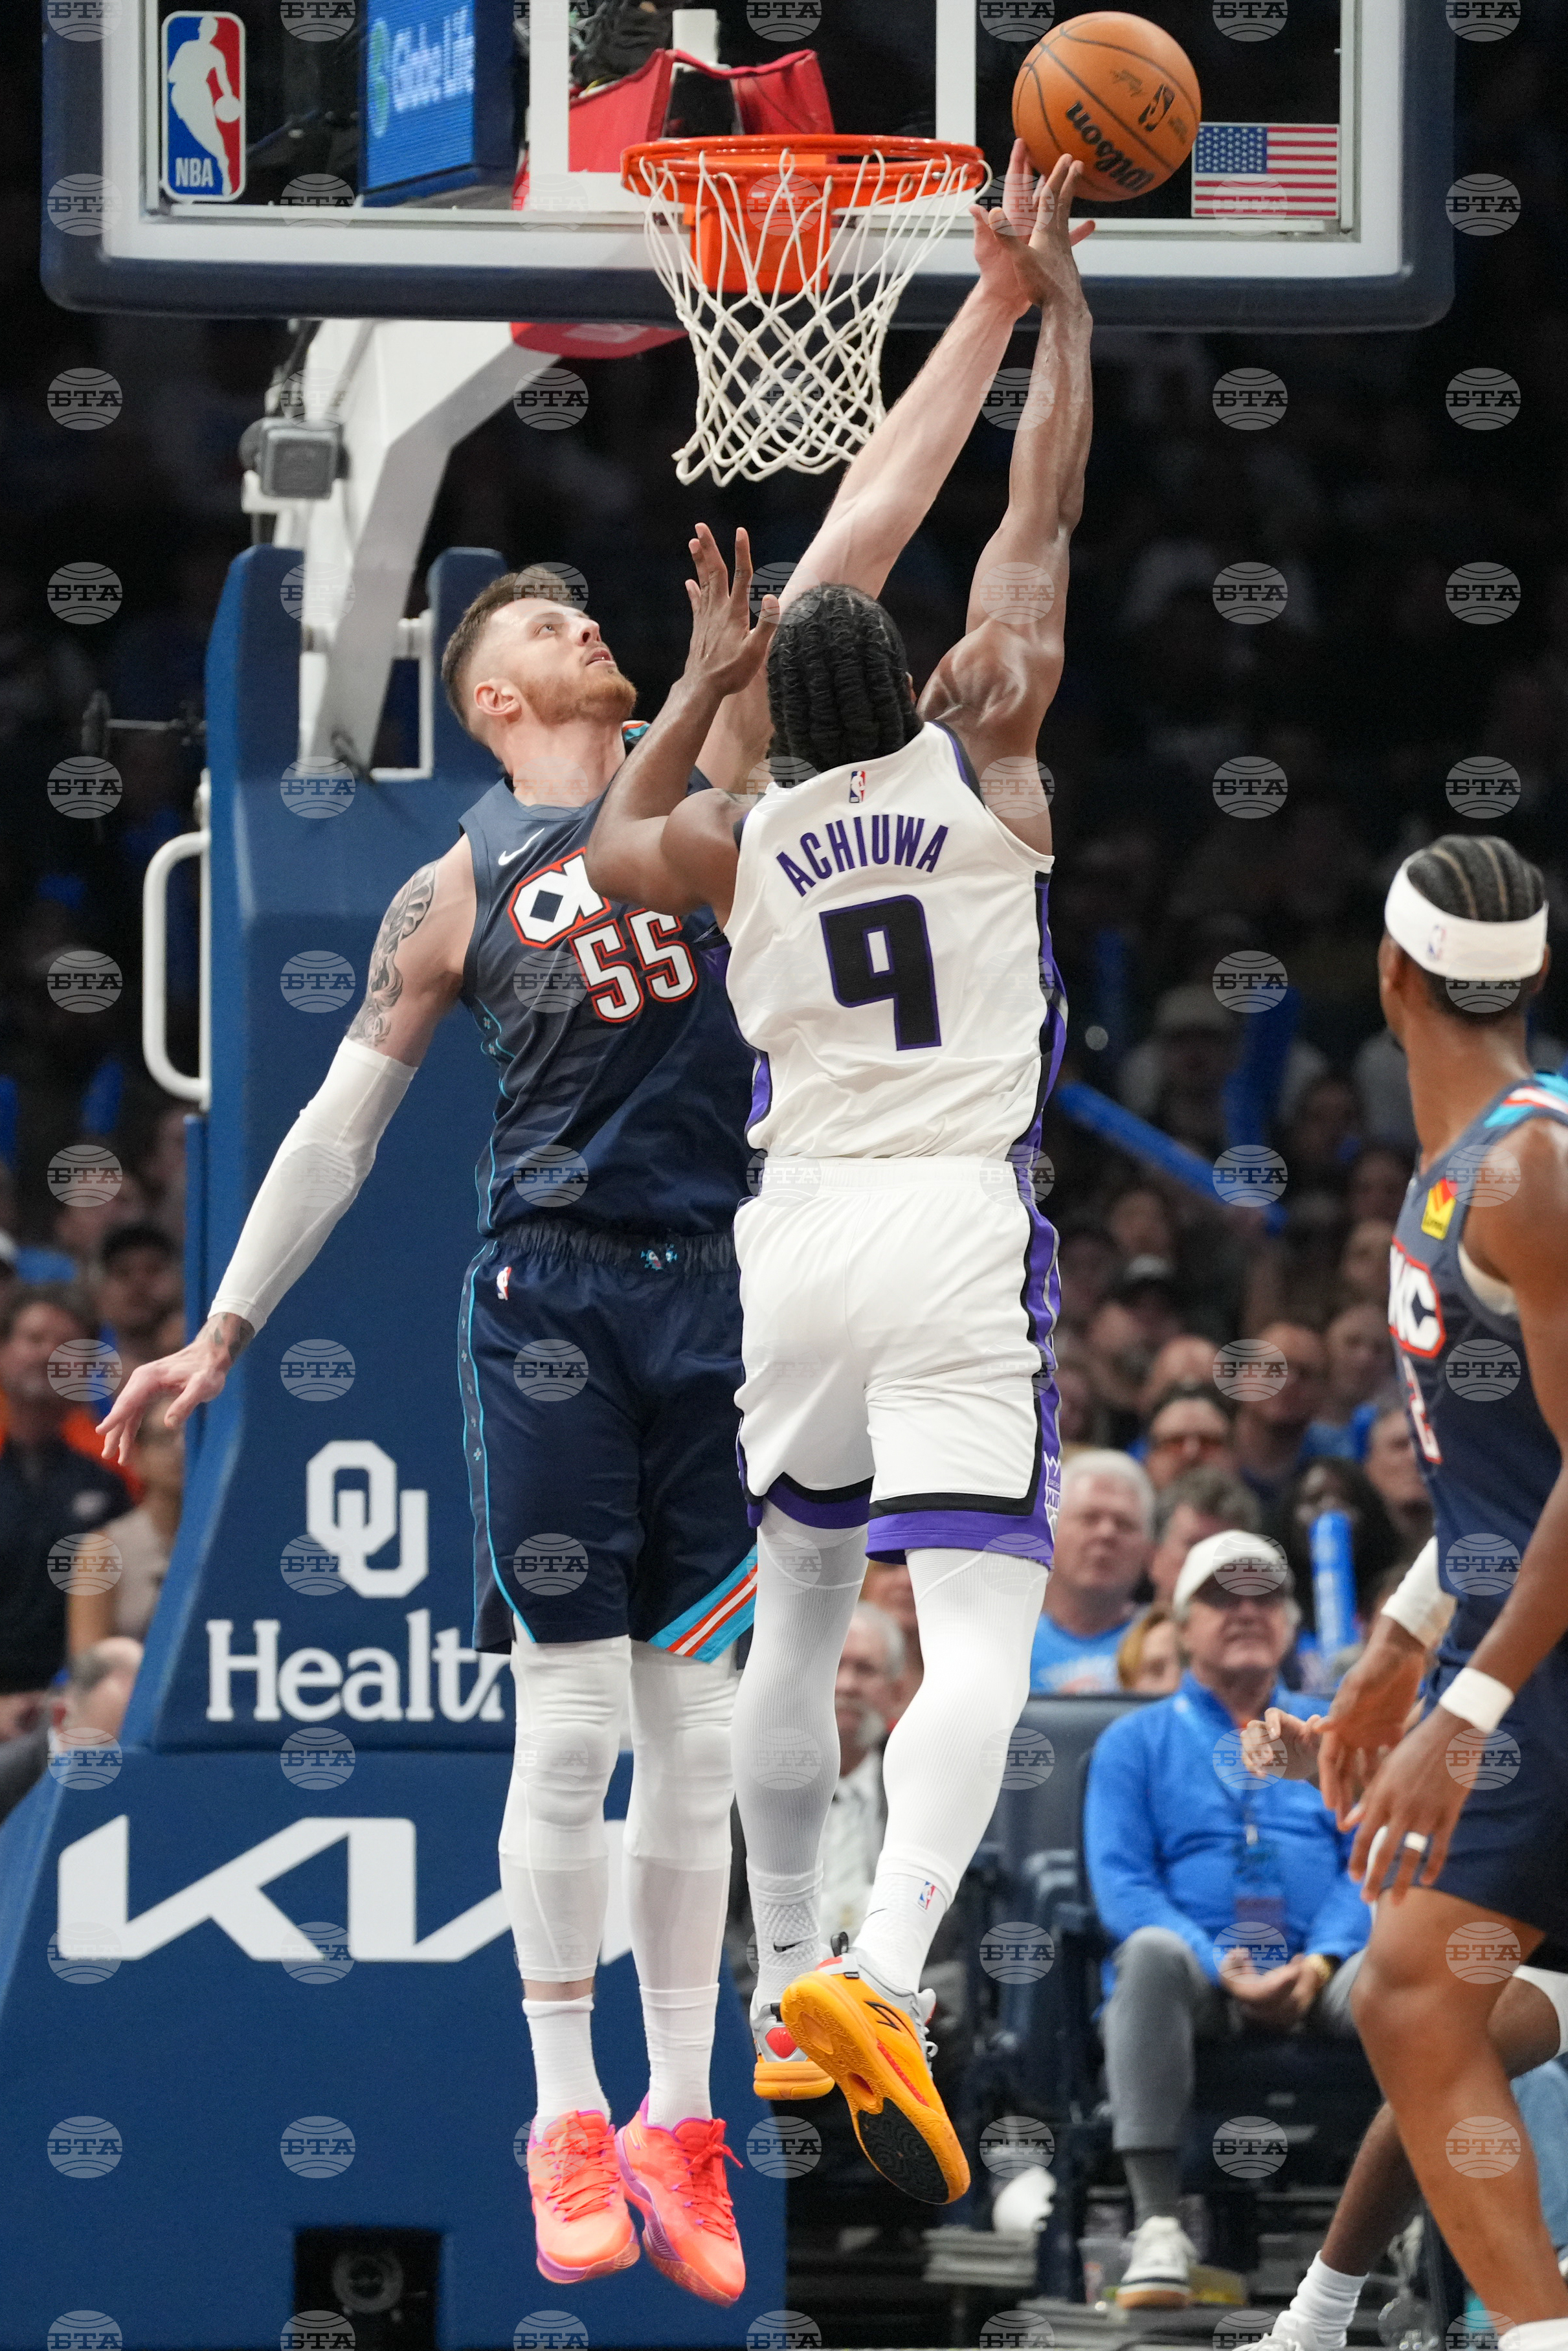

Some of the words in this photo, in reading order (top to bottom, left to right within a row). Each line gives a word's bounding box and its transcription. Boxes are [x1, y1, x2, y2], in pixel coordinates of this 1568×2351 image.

[175, 157, 214, 188] NBA
[776, 814, 950, 897] ACHIUWA
[569, 909, 697, 1022] 55
[819, 894, 942, 1051] 9
[306, 1439, 429, 1599] OU
